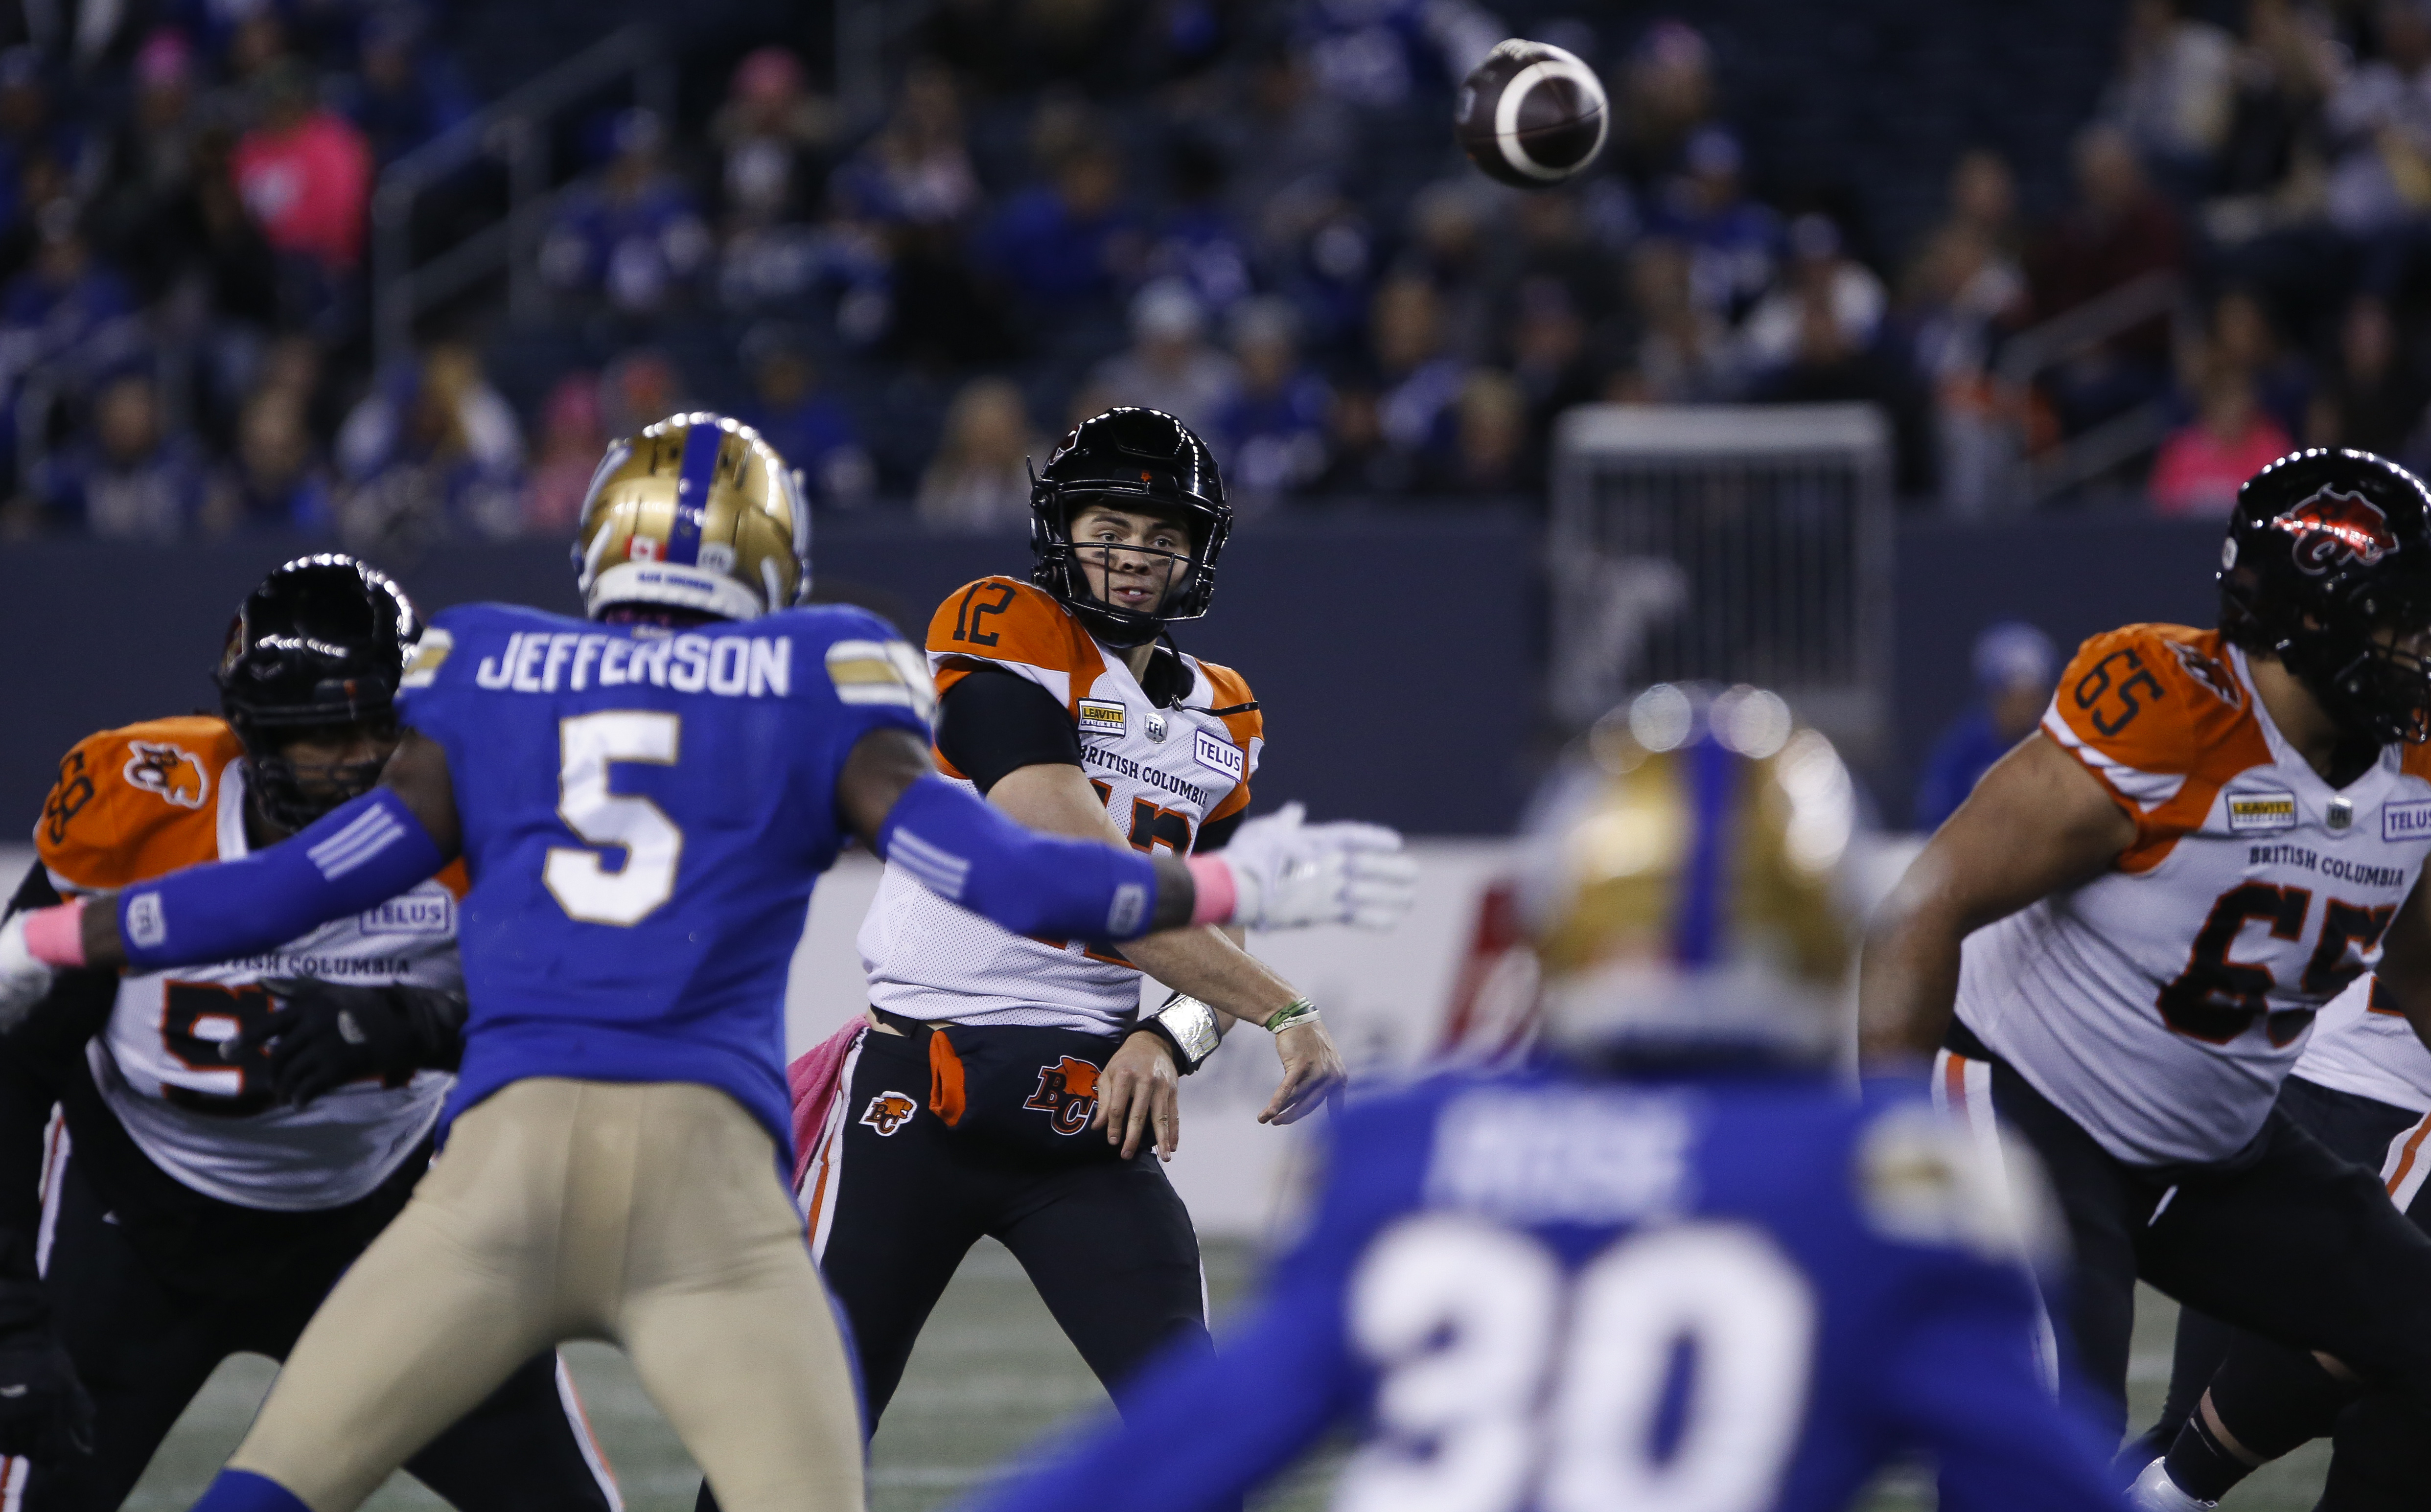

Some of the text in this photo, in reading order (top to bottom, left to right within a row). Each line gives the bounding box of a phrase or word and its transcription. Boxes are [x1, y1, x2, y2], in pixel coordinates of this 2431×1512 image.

[951, 581, 1017, 647] 12
[475, 630, 793, 697] JEFFERSON
[1083, 708, 1123, 721] LEAVITT
[2074, 647, 2164, 737] 65
[1148, 721, 1163, 737] CFL
[1199, 738, 1241, 772] TELUS
[1080, 745, 1139, 779] BRITISH
[541, 709, 684, 928] 5
[2249, 844, 2405, 887] BRITISH COLUMBIA
[288, 956, 410, 976] COLUMBIA
[2155, 880, 2398, 1048] 65
[859, 1099, 902, 1135] BC
[1023, 1066, 1093, 1135] BC
[1341, 1210, 1821, 1512] 30
